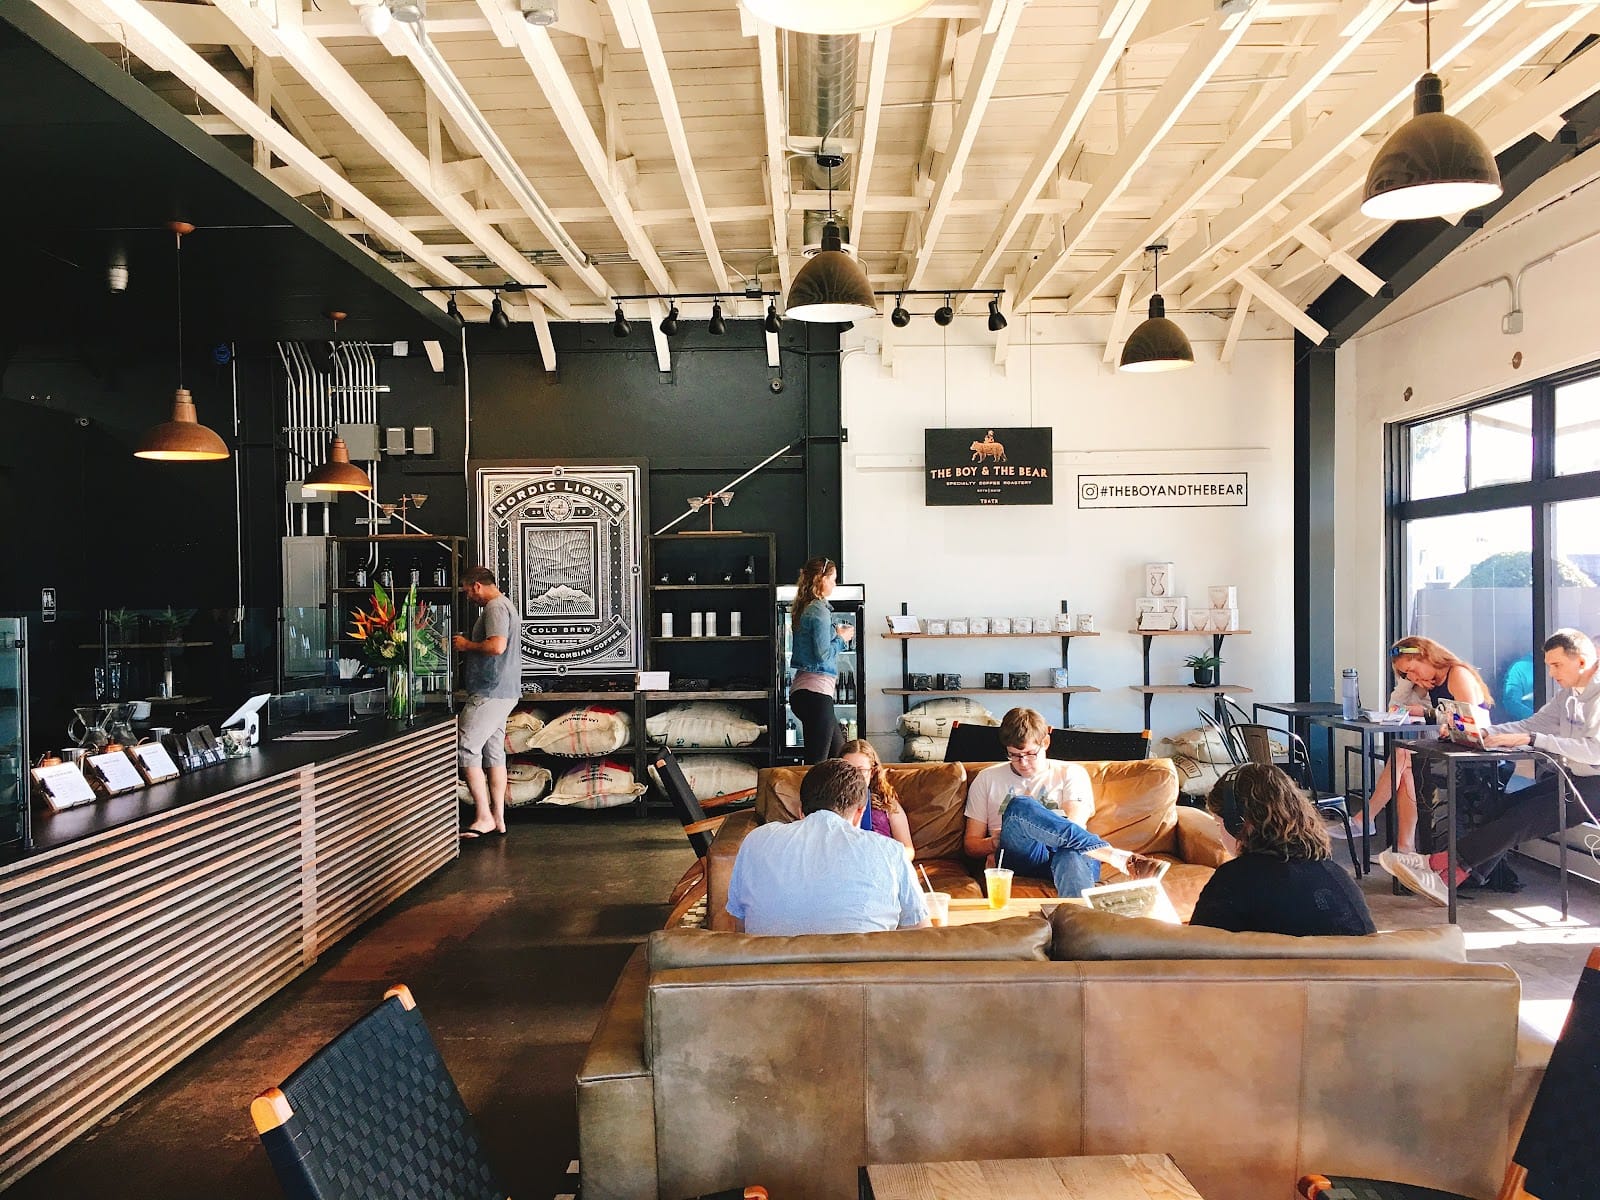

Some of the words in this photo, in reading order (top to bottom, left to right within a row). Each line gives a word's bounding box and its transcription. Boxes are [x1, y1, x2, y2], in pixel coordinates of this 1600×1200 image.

[930, 468, 952, 479] THE
[955, 466, 977, 477] BOY
[981, 467, 989, 476] &
[993, 466, 1015, 476] THE
[1019, 467, 1048, 478] BEAR
[496, 482, 556, 514] NORDIC
[564, 482, 622, 512] LIGHTS
[1100, 484, 1243, 497] #THEBOYANDTHEBEAR
[521, 645, 542, 656] ALTY
[544, 648, 592, 659] COLOMBIAN
[594, 630, 622, 650] COFFEE
